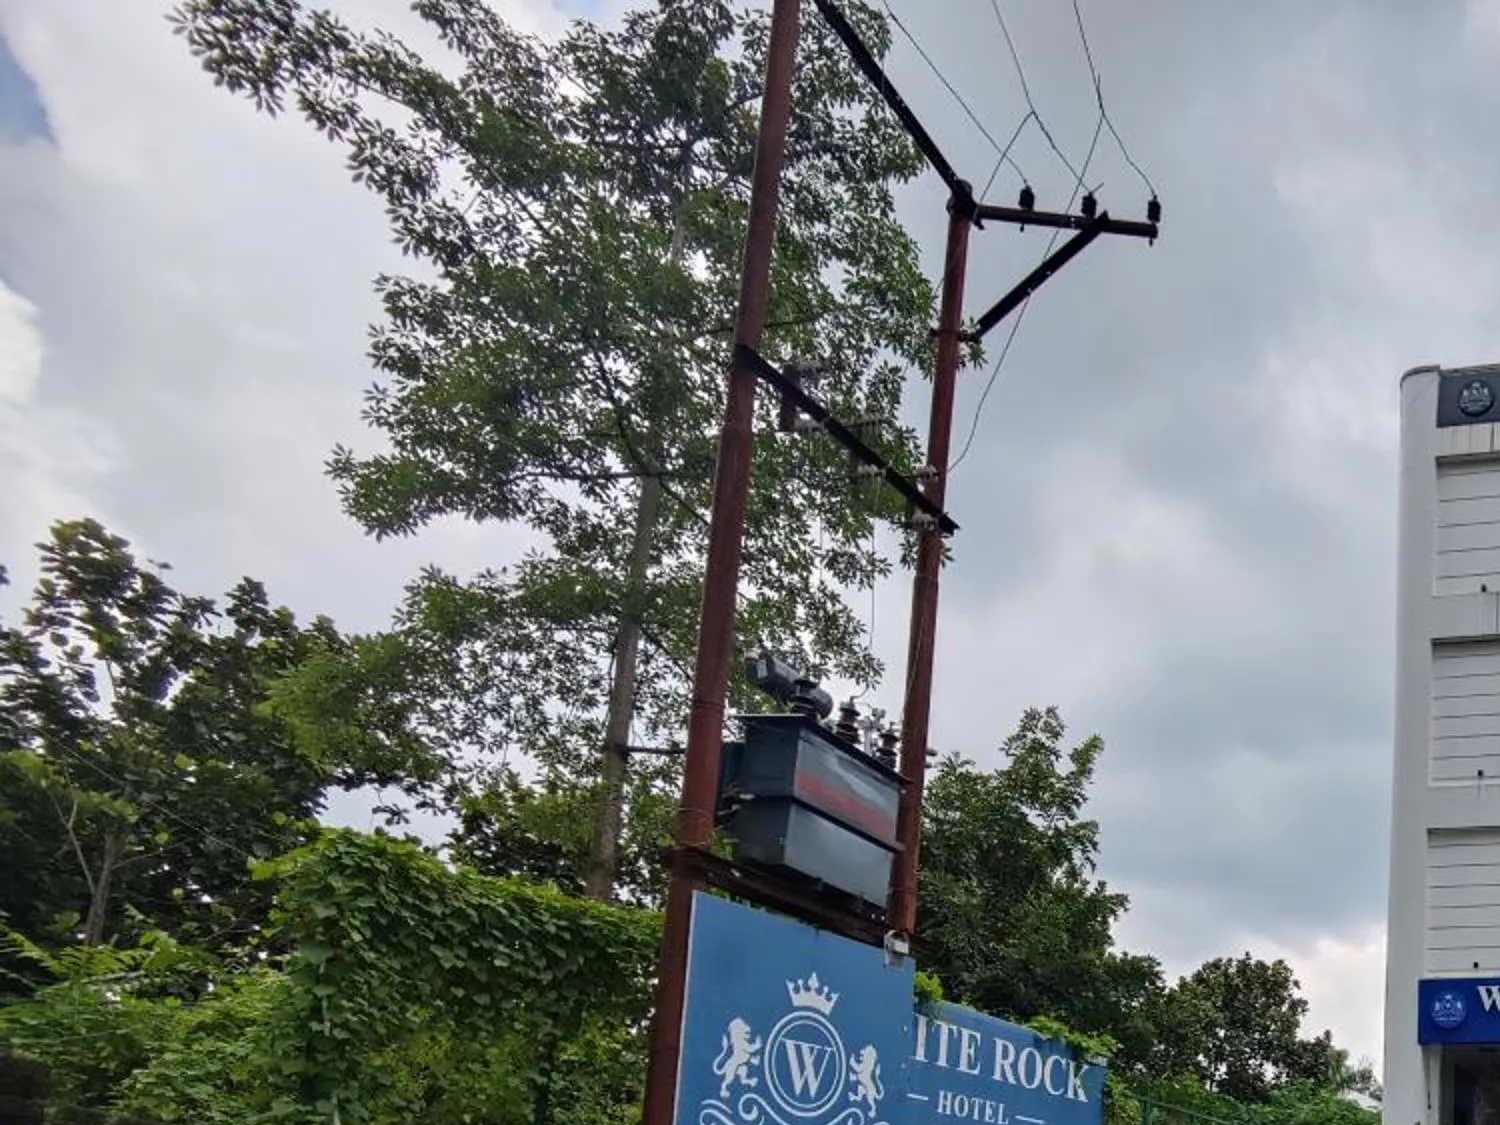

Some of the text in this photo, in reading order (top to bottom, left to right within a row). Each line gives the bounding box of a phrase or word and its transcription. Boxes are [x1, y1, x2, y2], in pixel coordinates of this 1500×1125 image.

[780, 1037, 836, 1099] W
[911, 1012, 1089, 1103] ITE ROCK
[937, 1090, 1009, 1125] HOTEL
